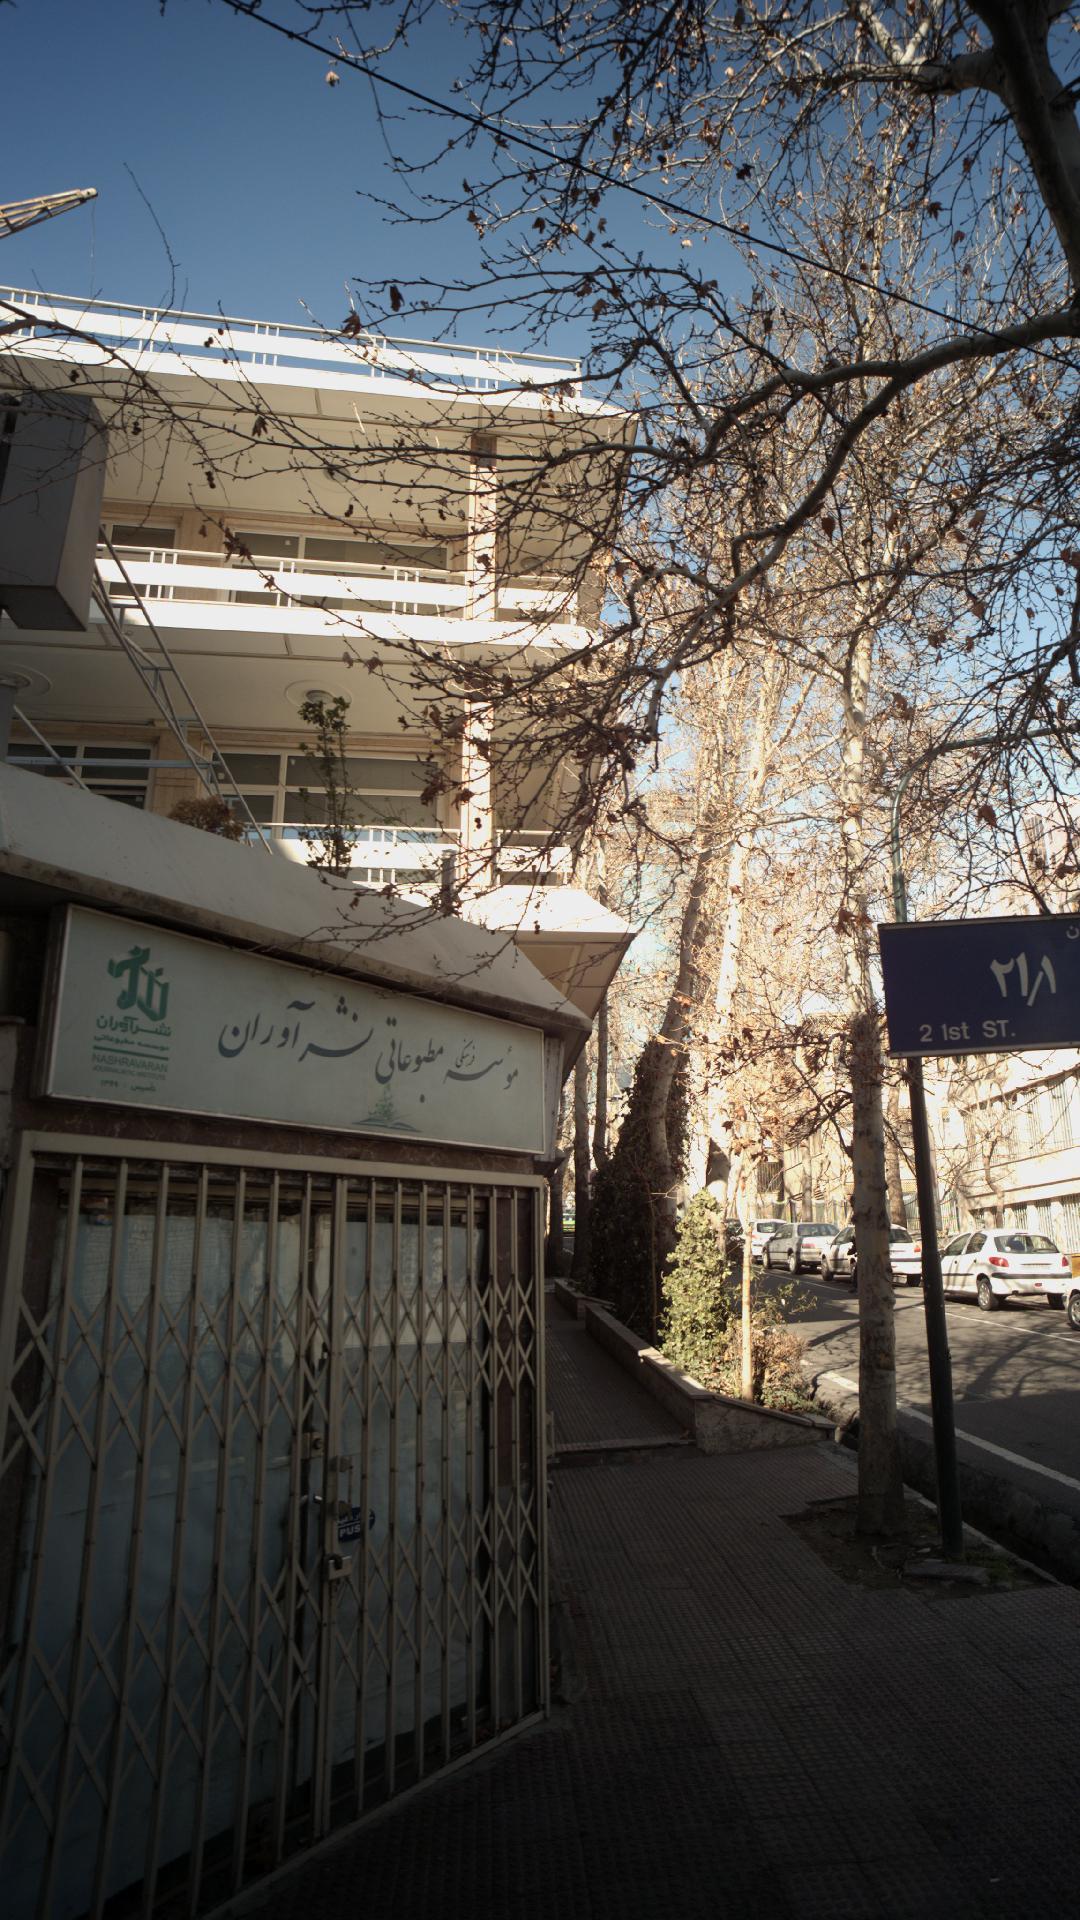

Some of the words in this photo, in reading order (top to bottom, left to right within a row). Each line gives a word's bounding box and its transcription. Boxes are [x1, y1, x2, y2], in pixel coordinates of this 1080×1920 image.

[982, 1019, 1016, 1038] ST.
[92, 1052, 168, 1073] NASHRAVARAN
[339, 1524, 360, 1537] PUS
